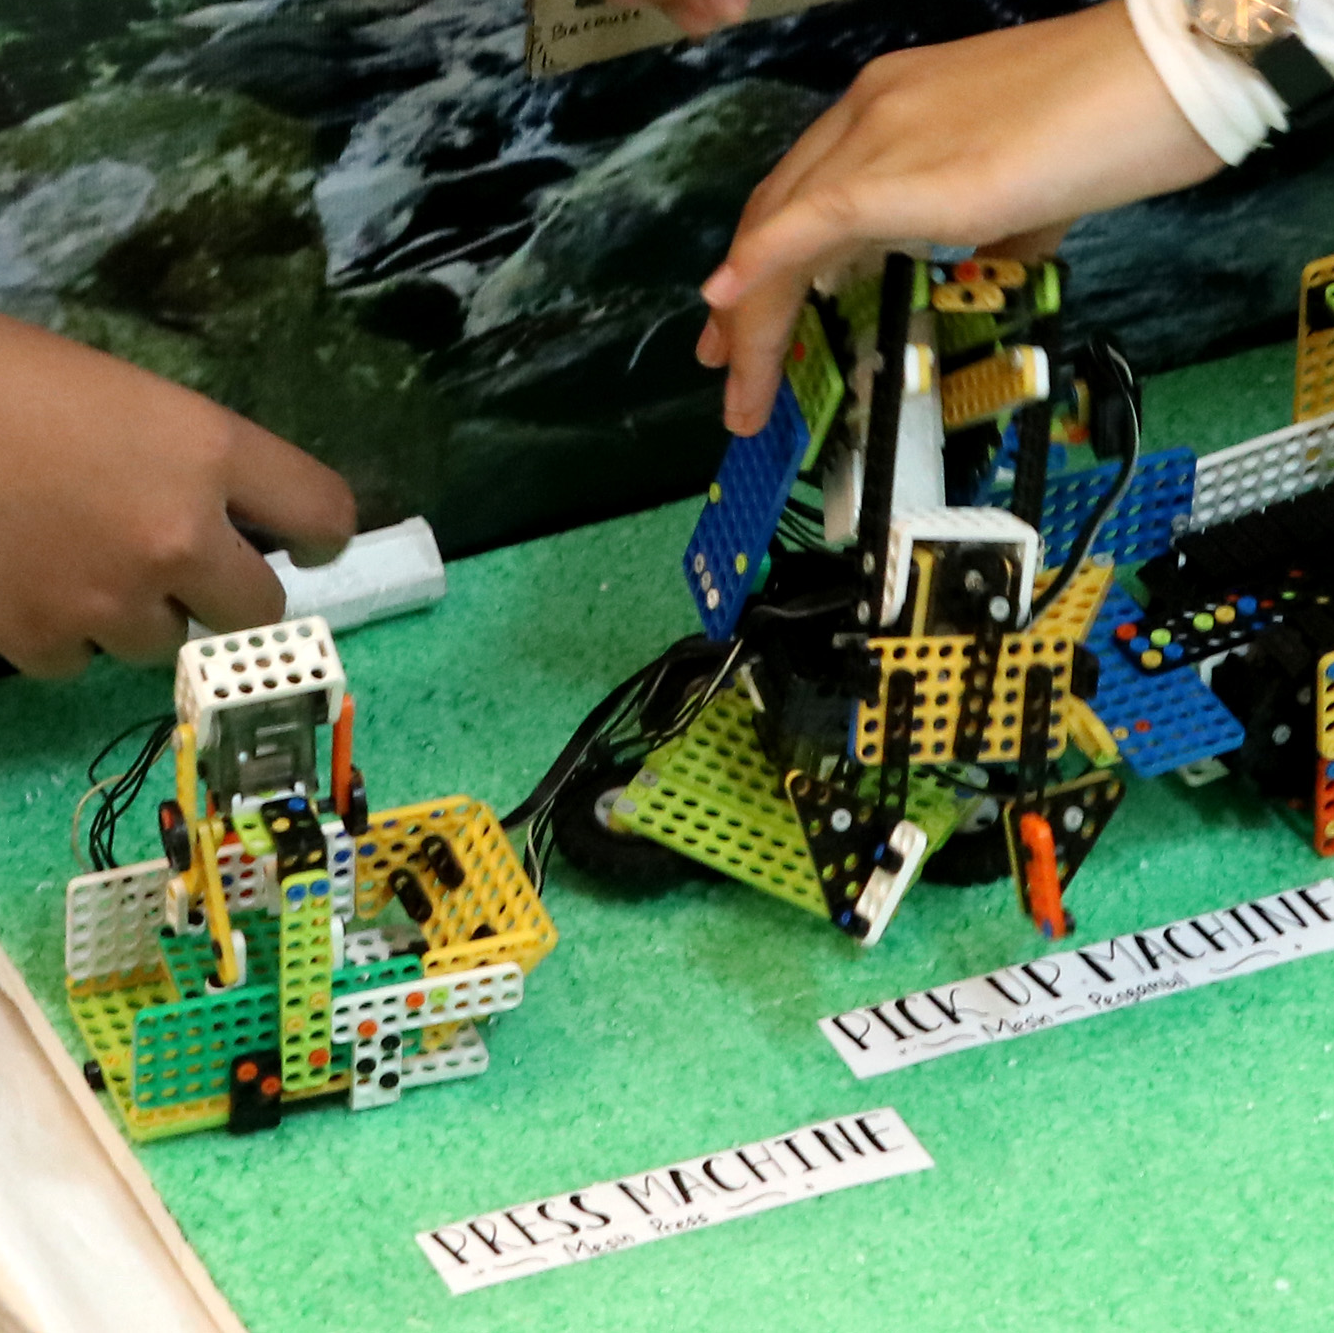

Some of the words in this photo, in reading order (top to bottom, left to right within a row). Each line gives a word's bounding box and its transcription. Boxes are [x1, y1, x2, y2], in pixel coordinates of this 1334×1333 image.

[830, 986, 991, 1051] PICK
[984, 958, 1064, 1007] UP
[980, 1012, 1053, 1041] Mesin
[429, 1192, 612, 1266] PRESS
[616, 1112, 905, 1217] MACHINE
[561, 1231, 637, 1264] Mesin
